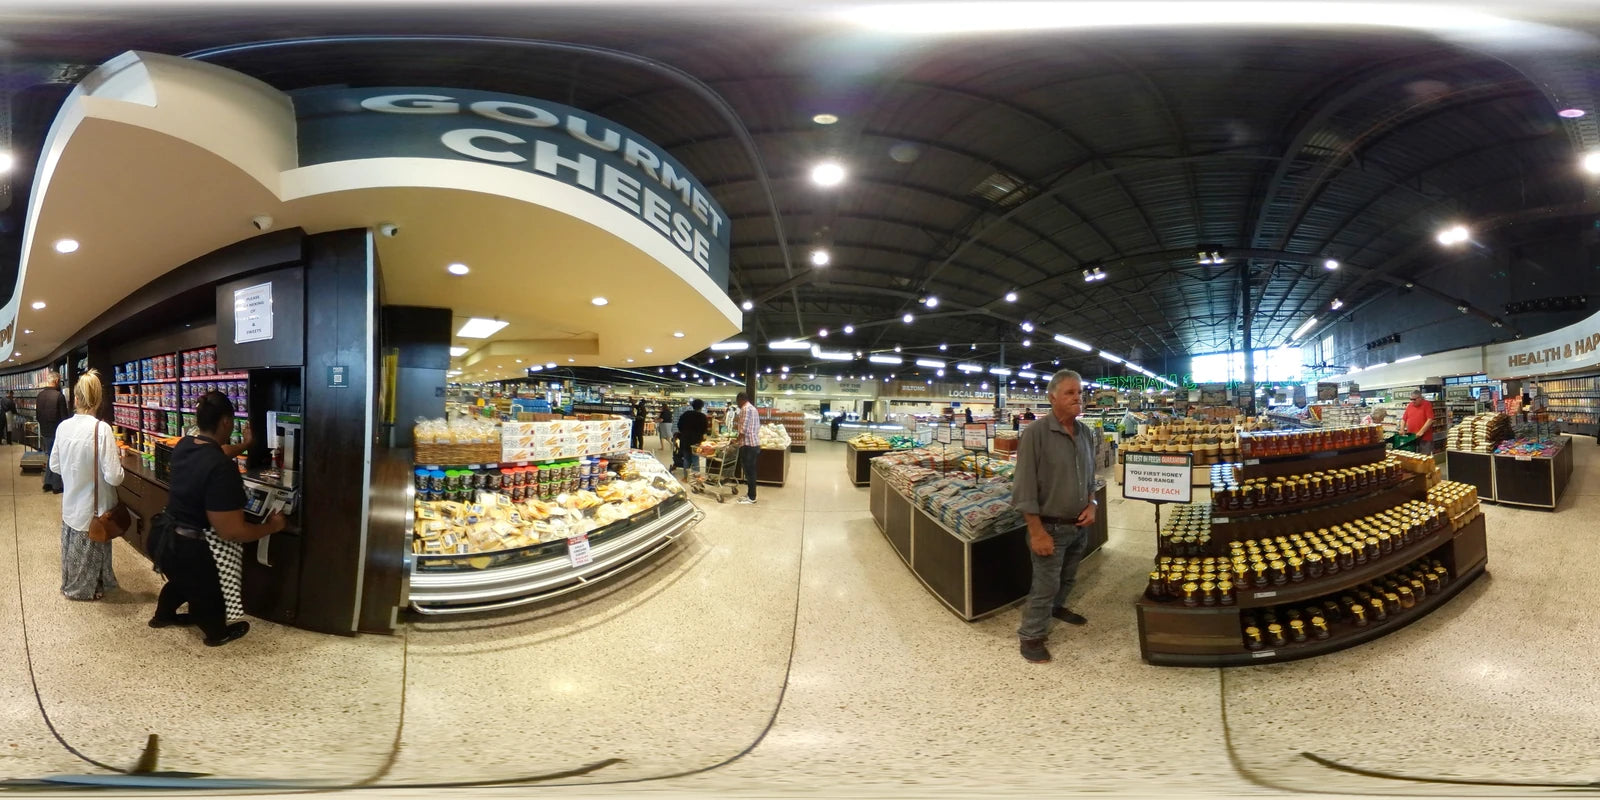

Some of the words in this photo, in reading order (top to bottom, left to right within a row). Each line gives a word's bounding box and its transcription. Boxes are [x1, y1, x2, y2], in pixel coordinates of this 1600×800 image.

[361, 94, 723, 238] GOURMET
[440, 128, 711, 272] CHEESE
[1508, 346, 1560, 367] HEALTH
[1564, 343, 1572, 358] &
[777, 383, 822, 392] SEAFOOD
[948, 390, 974, 398] LOCAL
[1132, 486, 1160, 494] R104.99
